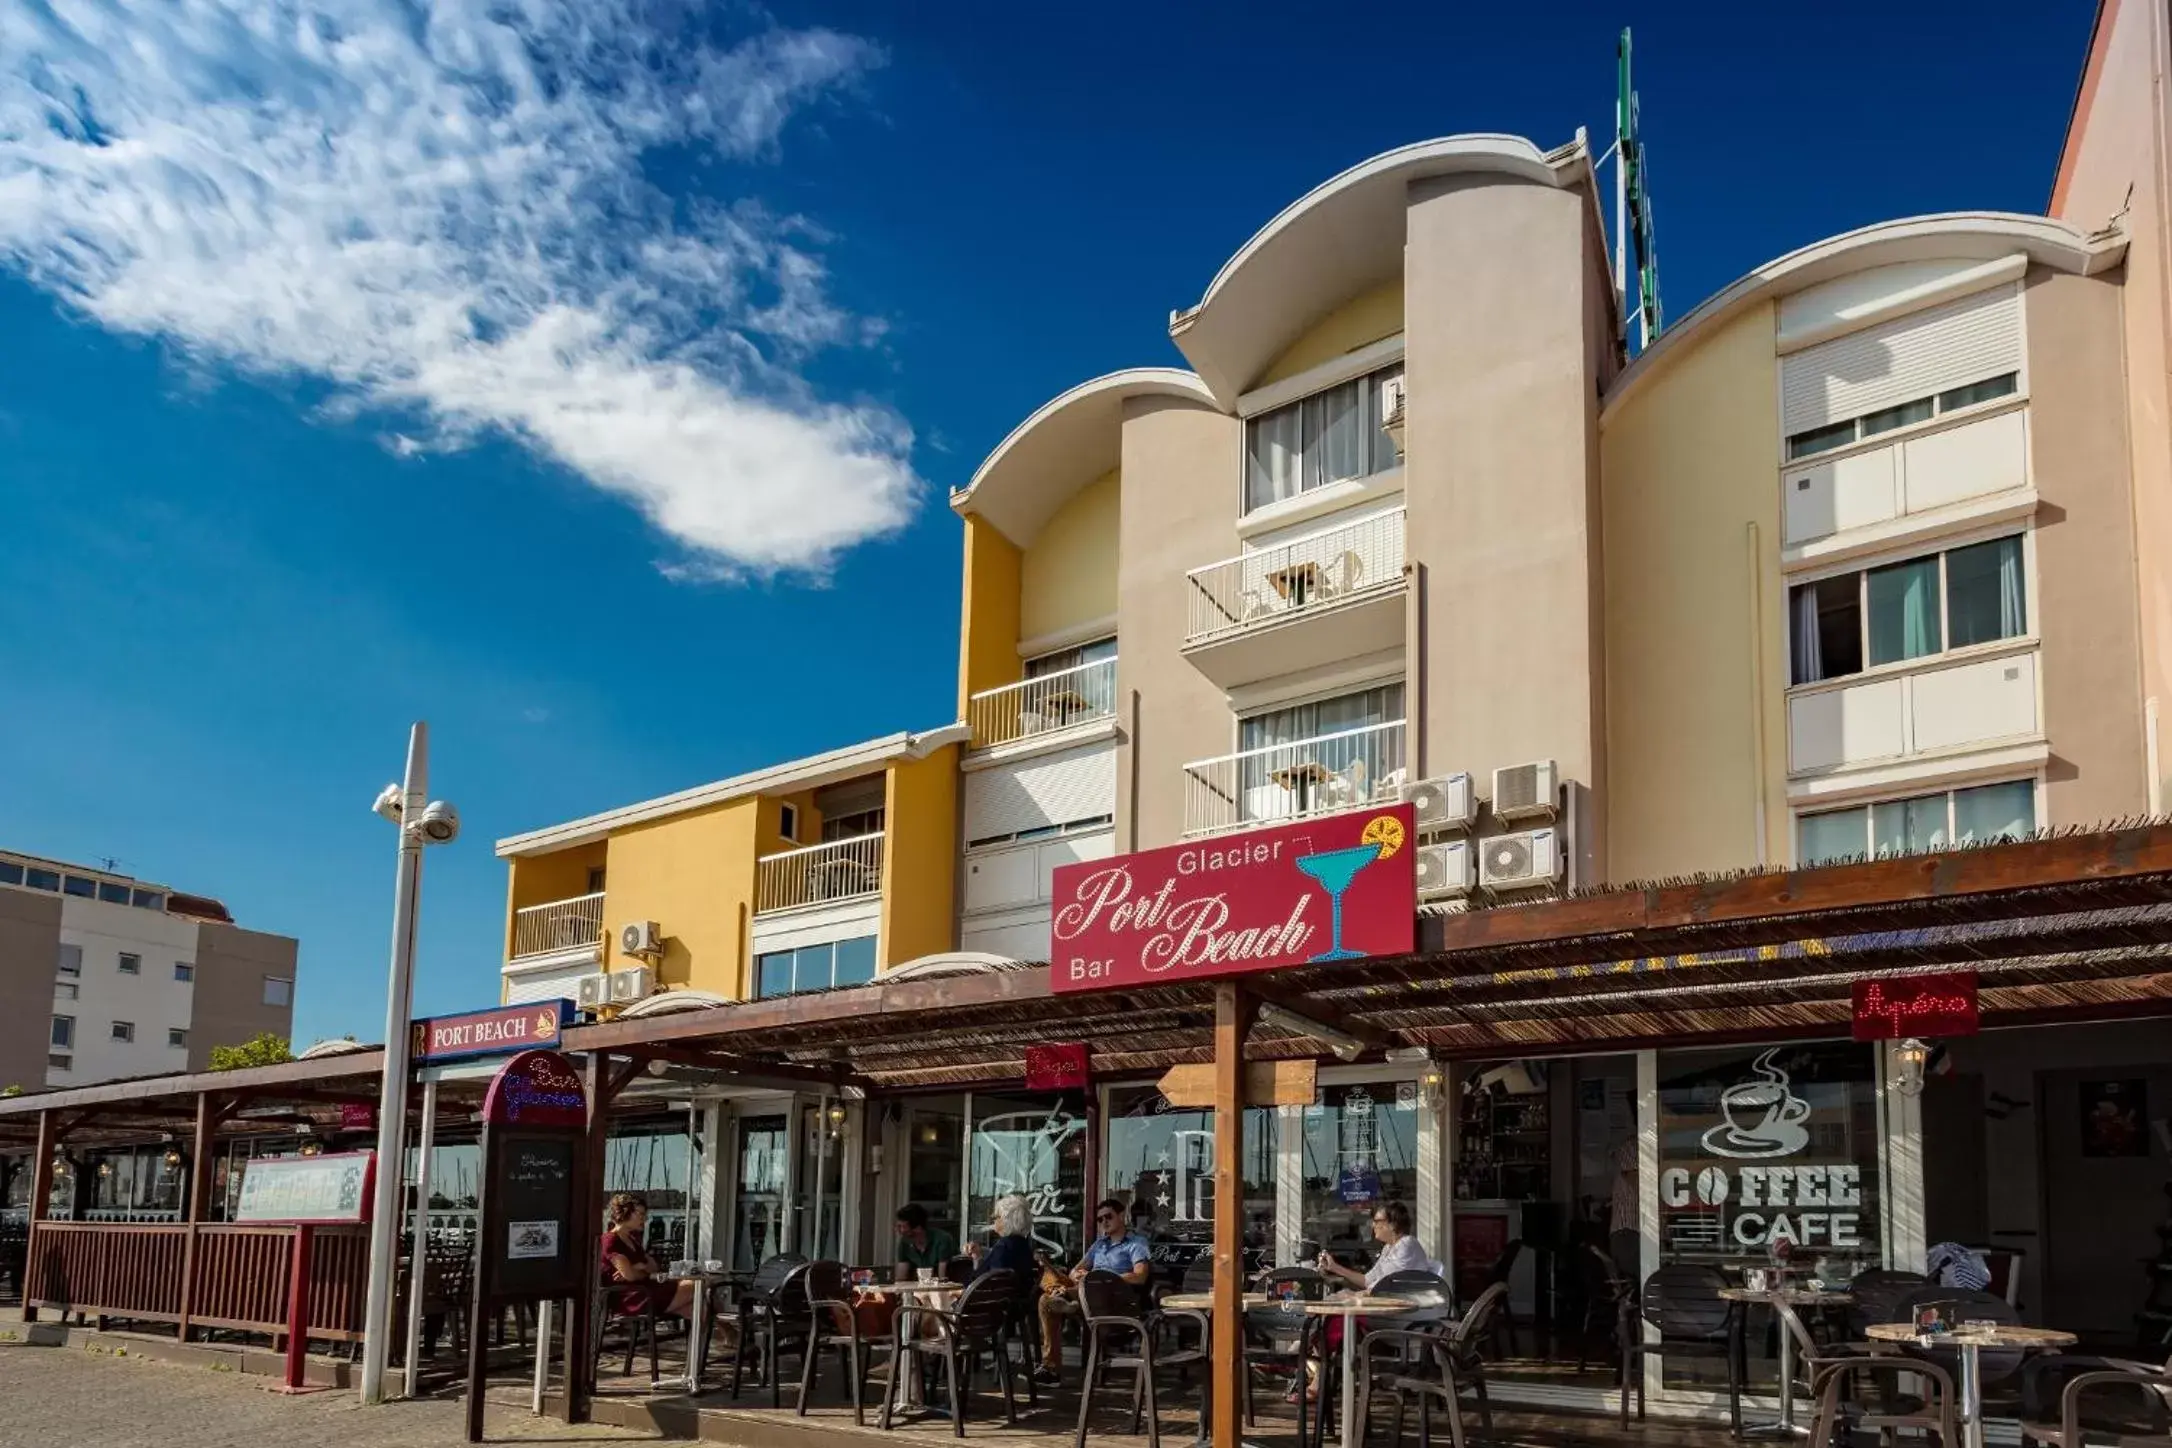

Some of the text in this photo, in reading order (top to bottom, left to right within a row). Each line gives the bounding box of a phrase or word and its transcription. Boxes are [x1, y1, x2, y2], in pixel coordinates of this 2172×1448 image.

[1177, 840, 1284, 876] Glacier
[1054, 863, 1177, 940] Port
[1141, 892, 1316, 973] Beach
[1070, 958, 1114, 981] Bar
[1858, 983, 1968, 1037] Apéro
[433, 1017, 527, 1048] PORT BEACH
[1660, 1165, 1861, 1208] COFFEE
[1732, 1212, 1861, 1247] CAFE
